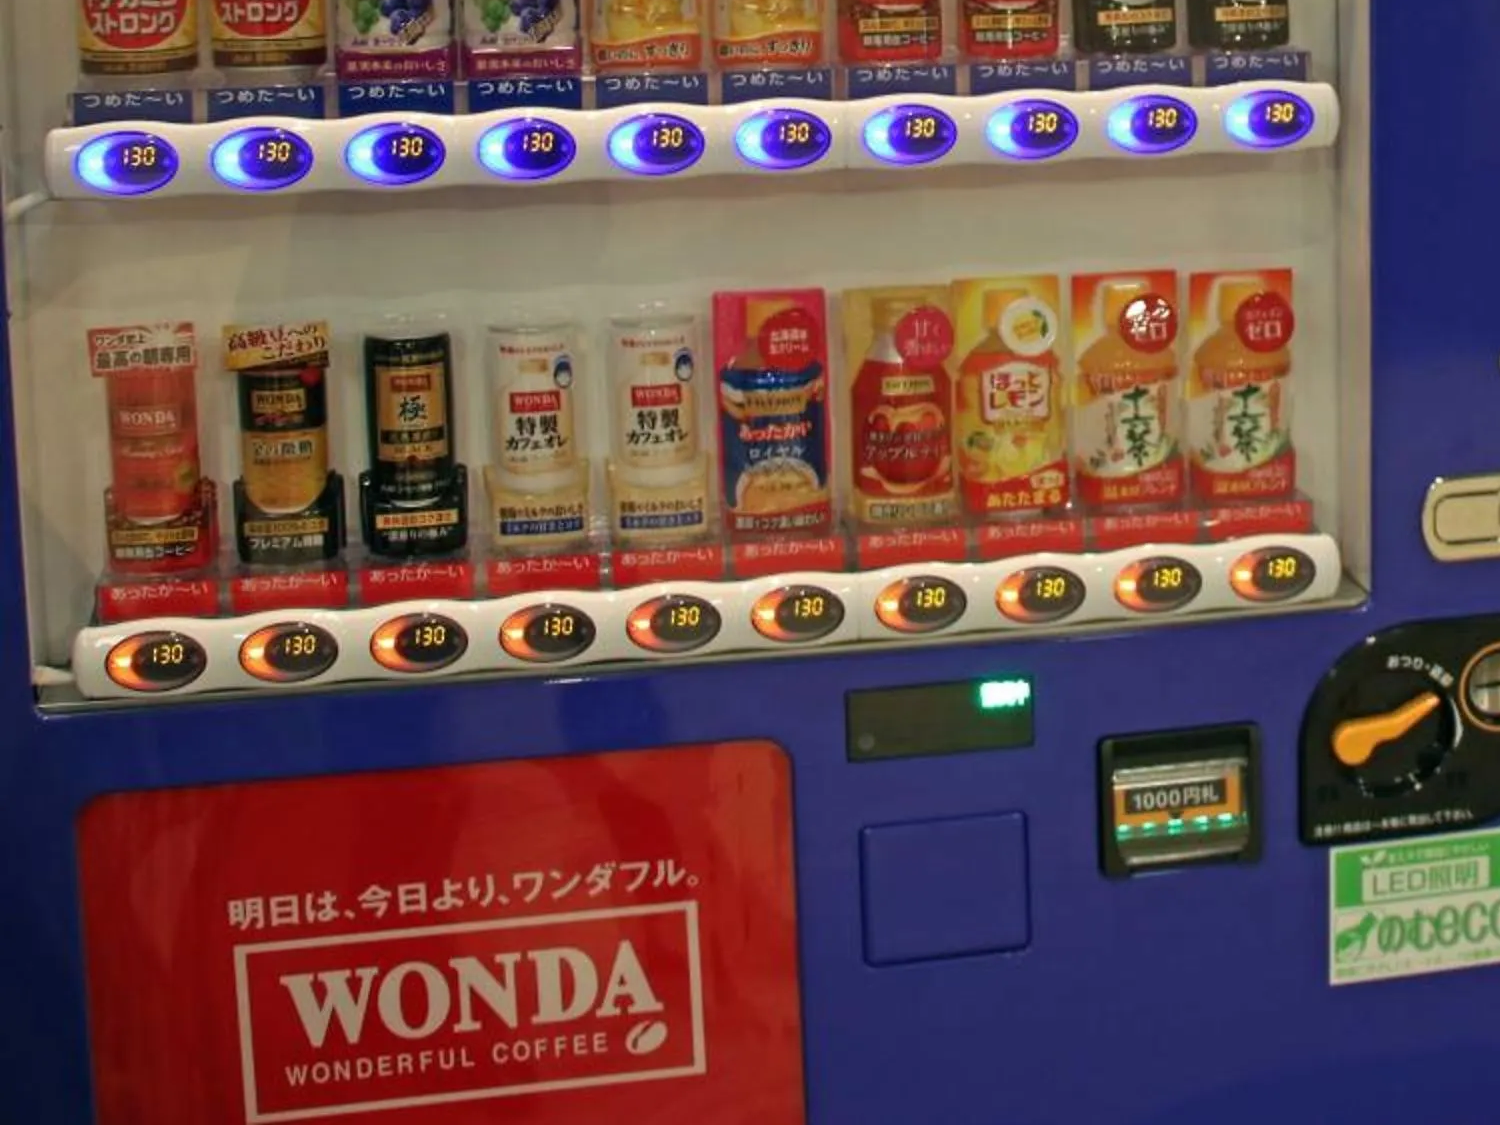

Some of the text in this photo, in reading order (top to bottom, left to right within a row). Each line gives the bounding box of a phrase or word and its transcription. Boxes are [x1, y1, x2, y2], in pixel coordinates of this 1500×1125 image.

[90, 11, 176, 35] ストロング
[221, 2, 300, 24] ストロング
[1028, 112, 1058, 133] 130
[1148, 107, 1178, 129] 130
[1264, 102, 1295, 124] 130
[652, 126, 684, 148] 130
[779, 122, 810, 143] 130
[905, 117, 936, 139] 130
[258, 141, 291, 162] 130
[391, 136, 424, 158] 130
[522, 131, 554, 153] 130
[123, 146, 157, 167] 130
[1247, 320, 1282, 341] ゼロ
[254, 392, 303, 405] WONDA
[398, 394, 428, 422] 極
[513, 393, 558, 407] WONDA
[989, 391, 1046, 411] レモン
[119, 409, 177, 425] WONDA
[514, 414, 561, 436] 特製
[636, 408, 681, 430] 特製
[505, 435, 568, 452] カフェオレ
[626, 430, 689, 445] カフェオレ
[1153, 567, 1182, 588] 130
[1267, 556, 1297, 578] 130
[916, 587, 946, 608] 130
[1036, 577, 1065, 598] 130
[670, 605, 701, 626] 130
[793, 596, 825, 617] 130
[414, 625, 446, 647] 130
[543, 615, 574, 637] 130
[152, 643, 184, 665] 130
[283, 633, 317, 656] 130
[1132, 782, 1220, 811] 1000円札
[1371, 860, 1479, 897] LED照明
[227, 858, 701, 931] 明日は、今日より、ワンダフル。
[279, 938, 664, 1050] WONDA
[284, 1030, 611, 1088] WONDERFUL COFFEE
